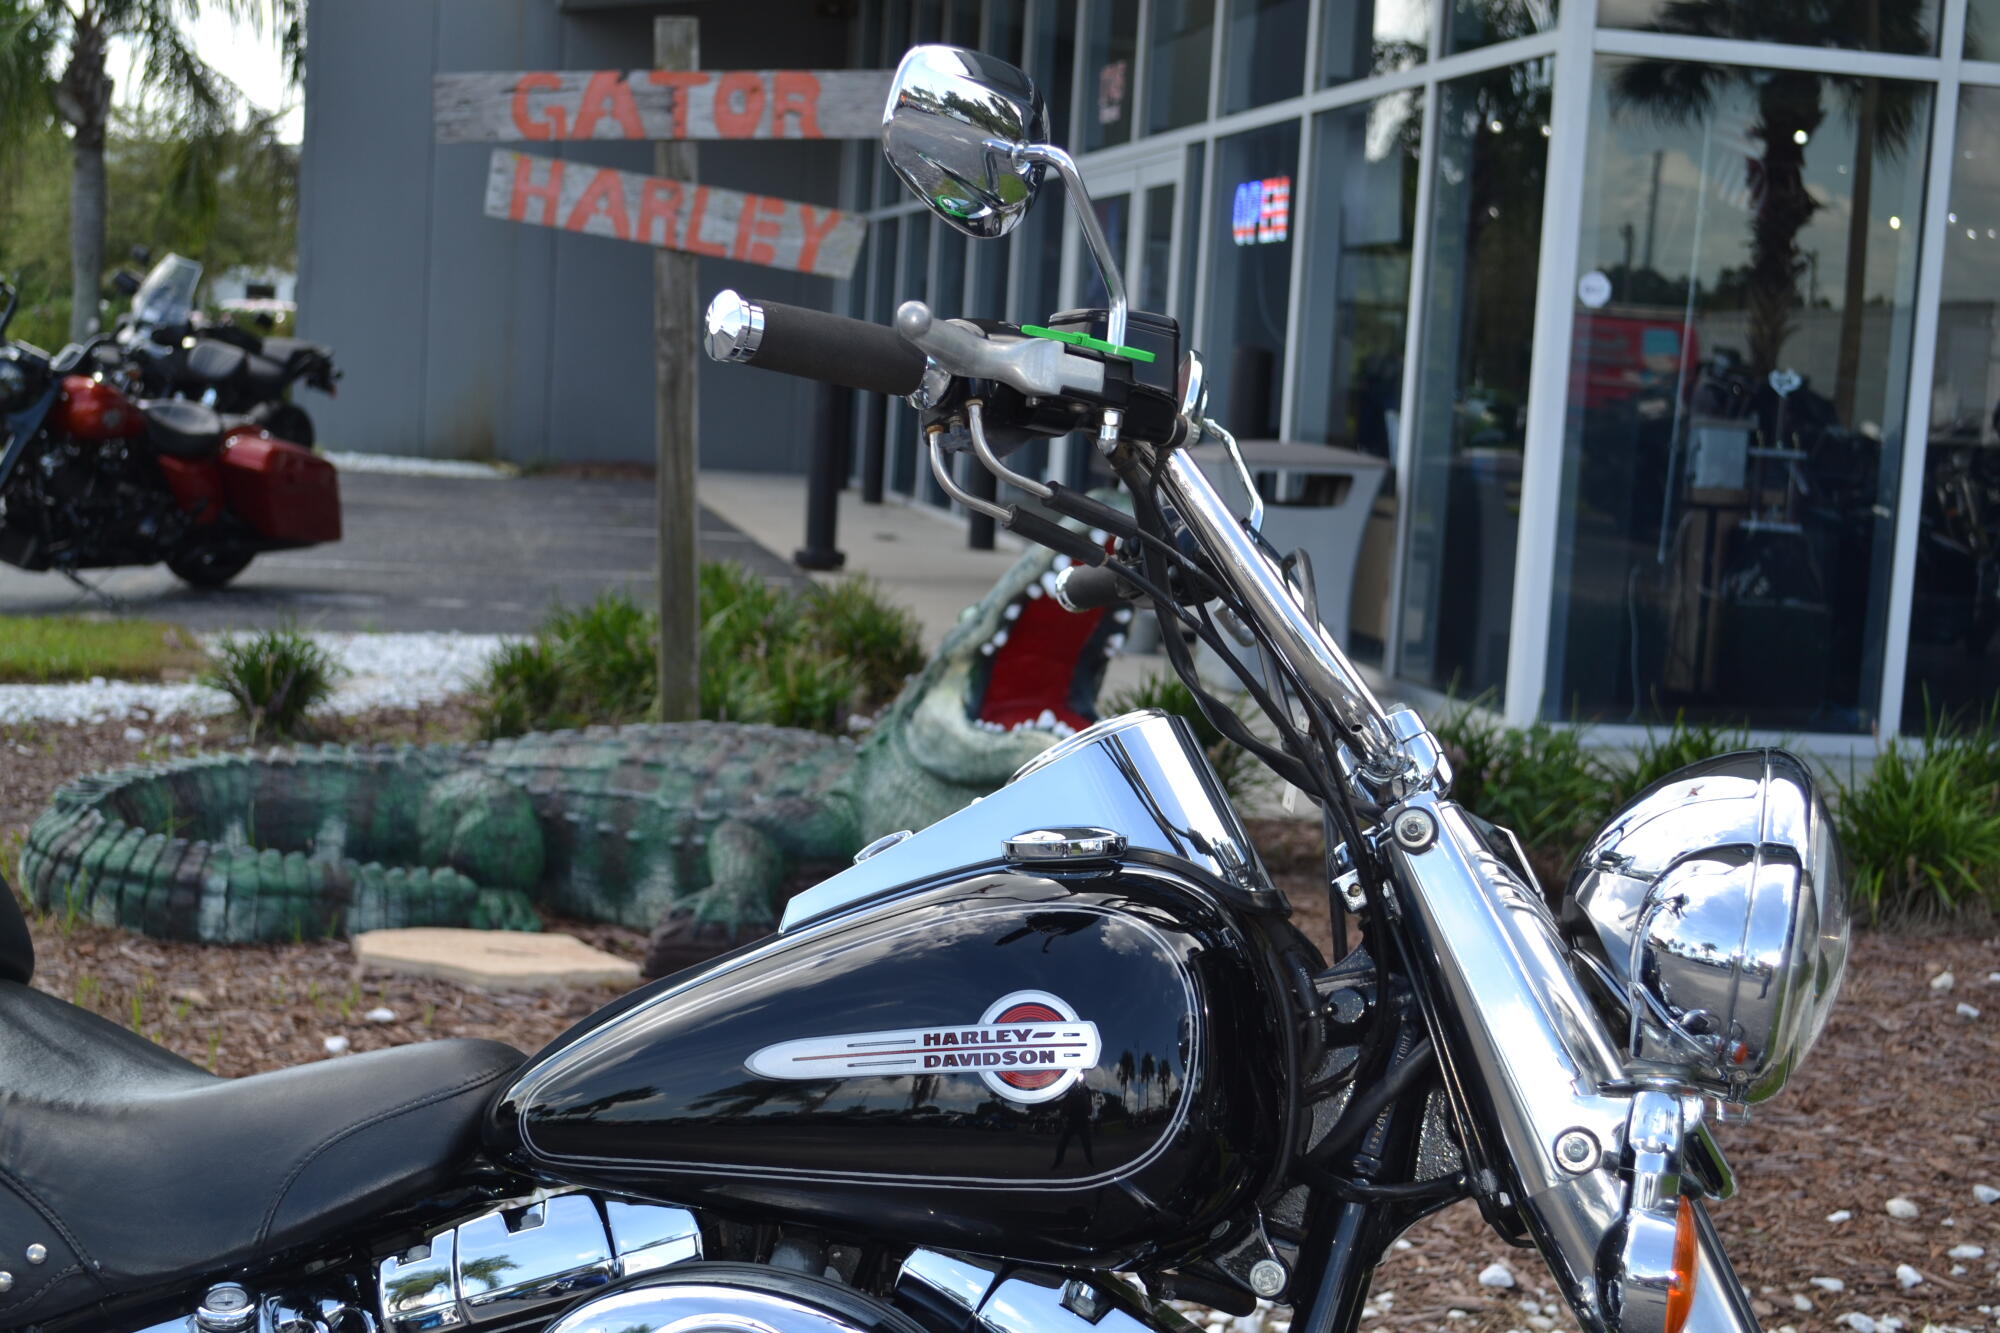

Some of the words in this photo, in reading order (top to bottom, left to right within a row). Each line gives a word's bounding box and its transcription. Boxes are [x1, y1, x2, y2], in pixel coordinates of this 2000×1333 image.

[512, 70, 824, 139] GATOR
[508, 154, 842, 273] HARLEY
[923, 1050, 1056, 1068] DAVIDSON
